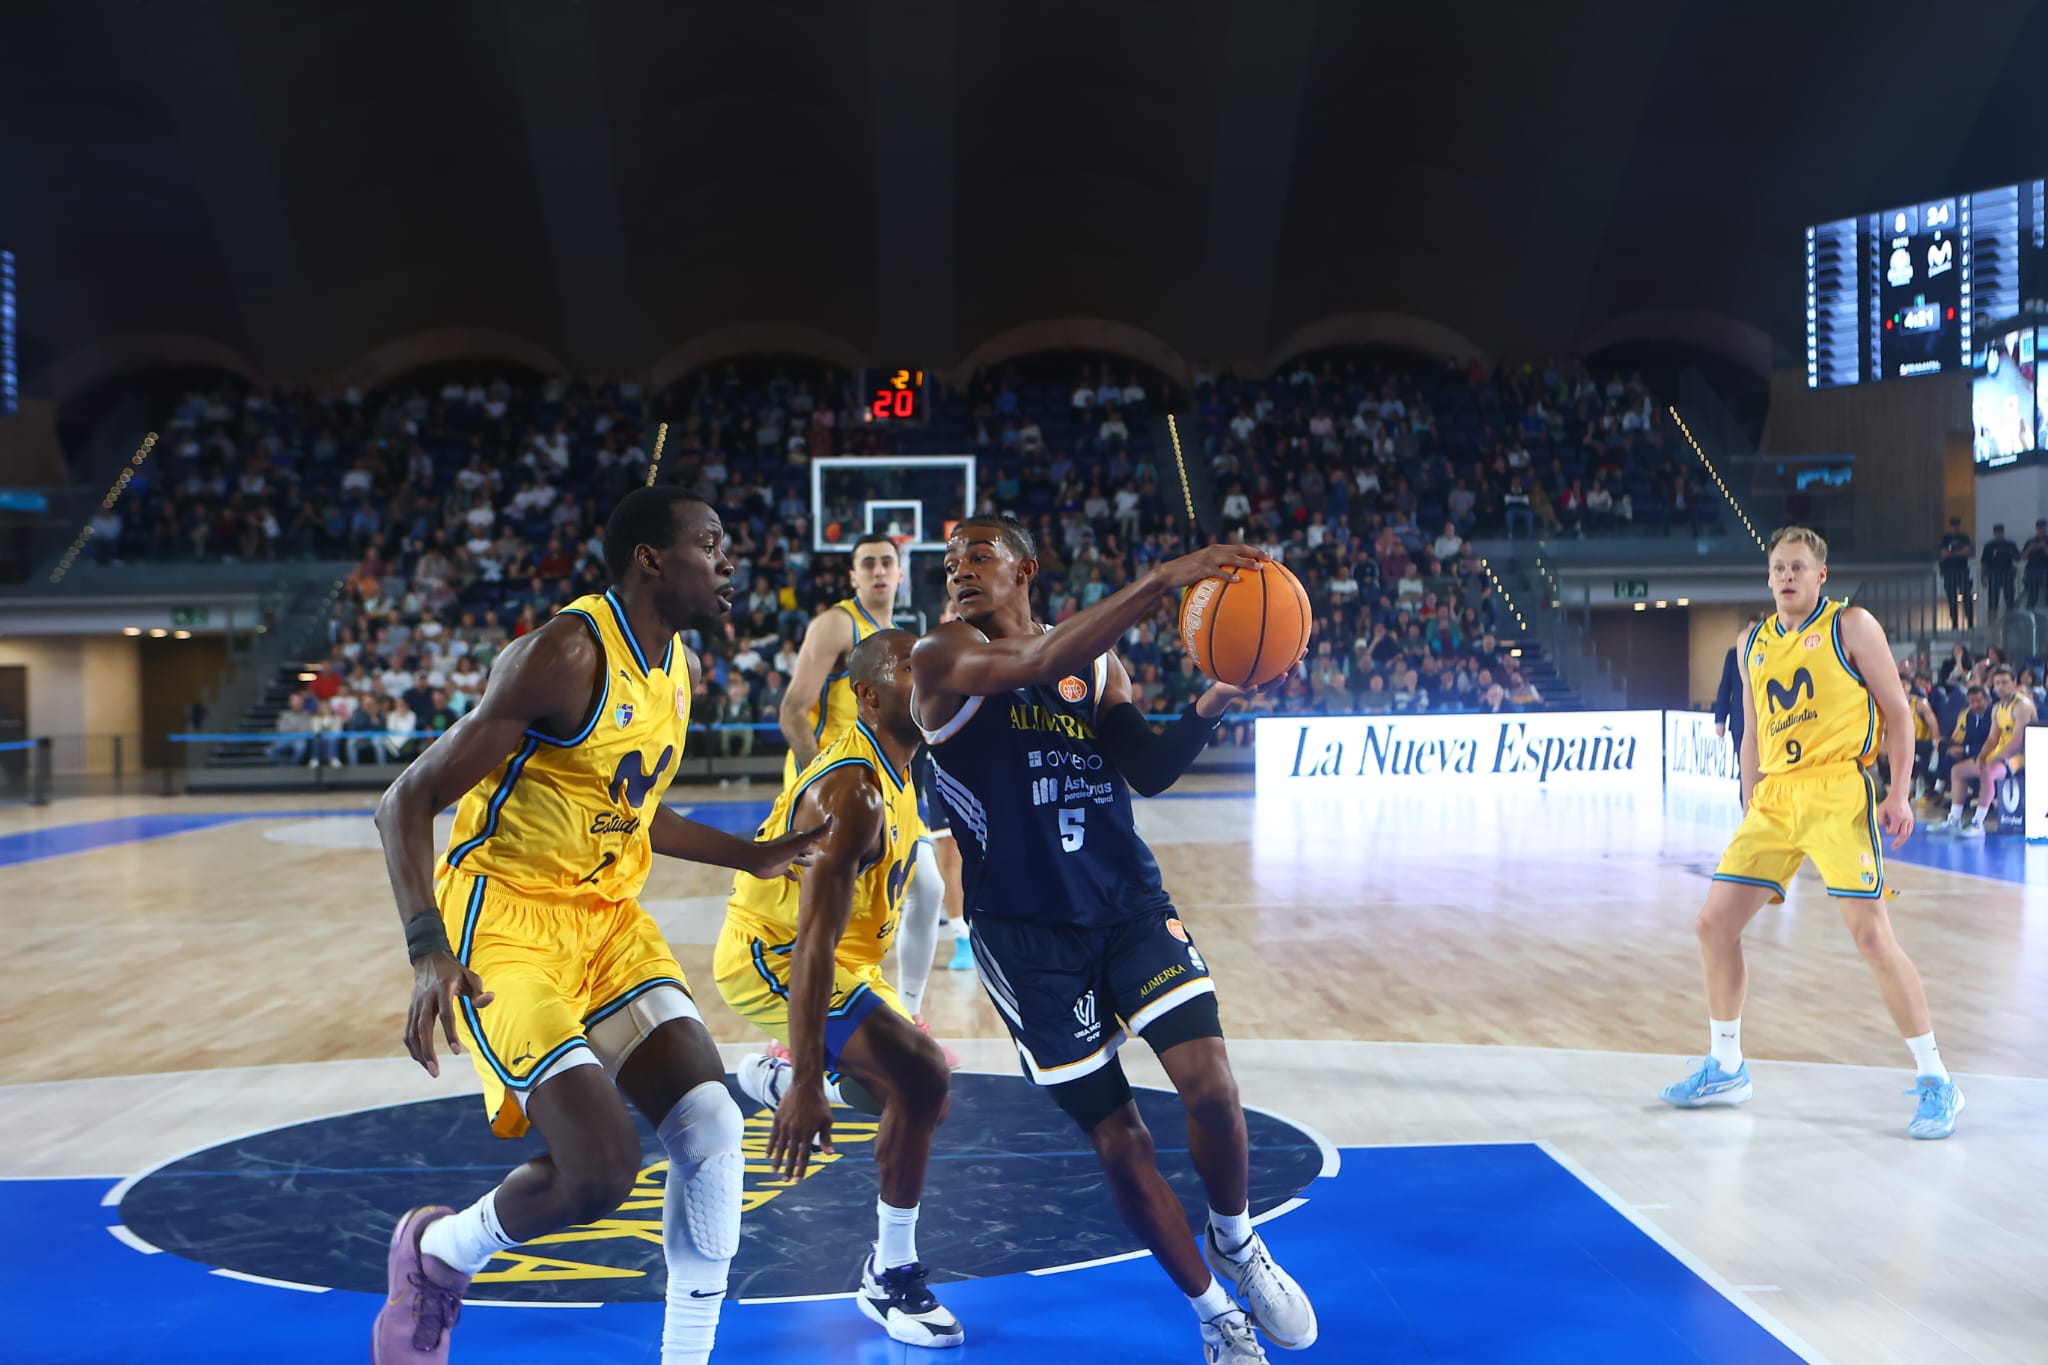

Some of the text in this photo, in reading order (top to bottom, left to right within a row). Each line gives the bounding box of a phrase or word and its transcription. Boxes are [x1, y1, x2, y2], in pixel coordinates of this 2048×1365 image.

[872, 390, 914, 418] 20
[1769, 708, 1818, 737] Estudiantes
[1288, 721, 1637, 783] La Nueva España
[1786, 739, 1802, 764] 9
[1058, 807, 1086, 853] 5
[1139, 963, 1186, 998] ALIMERKA
